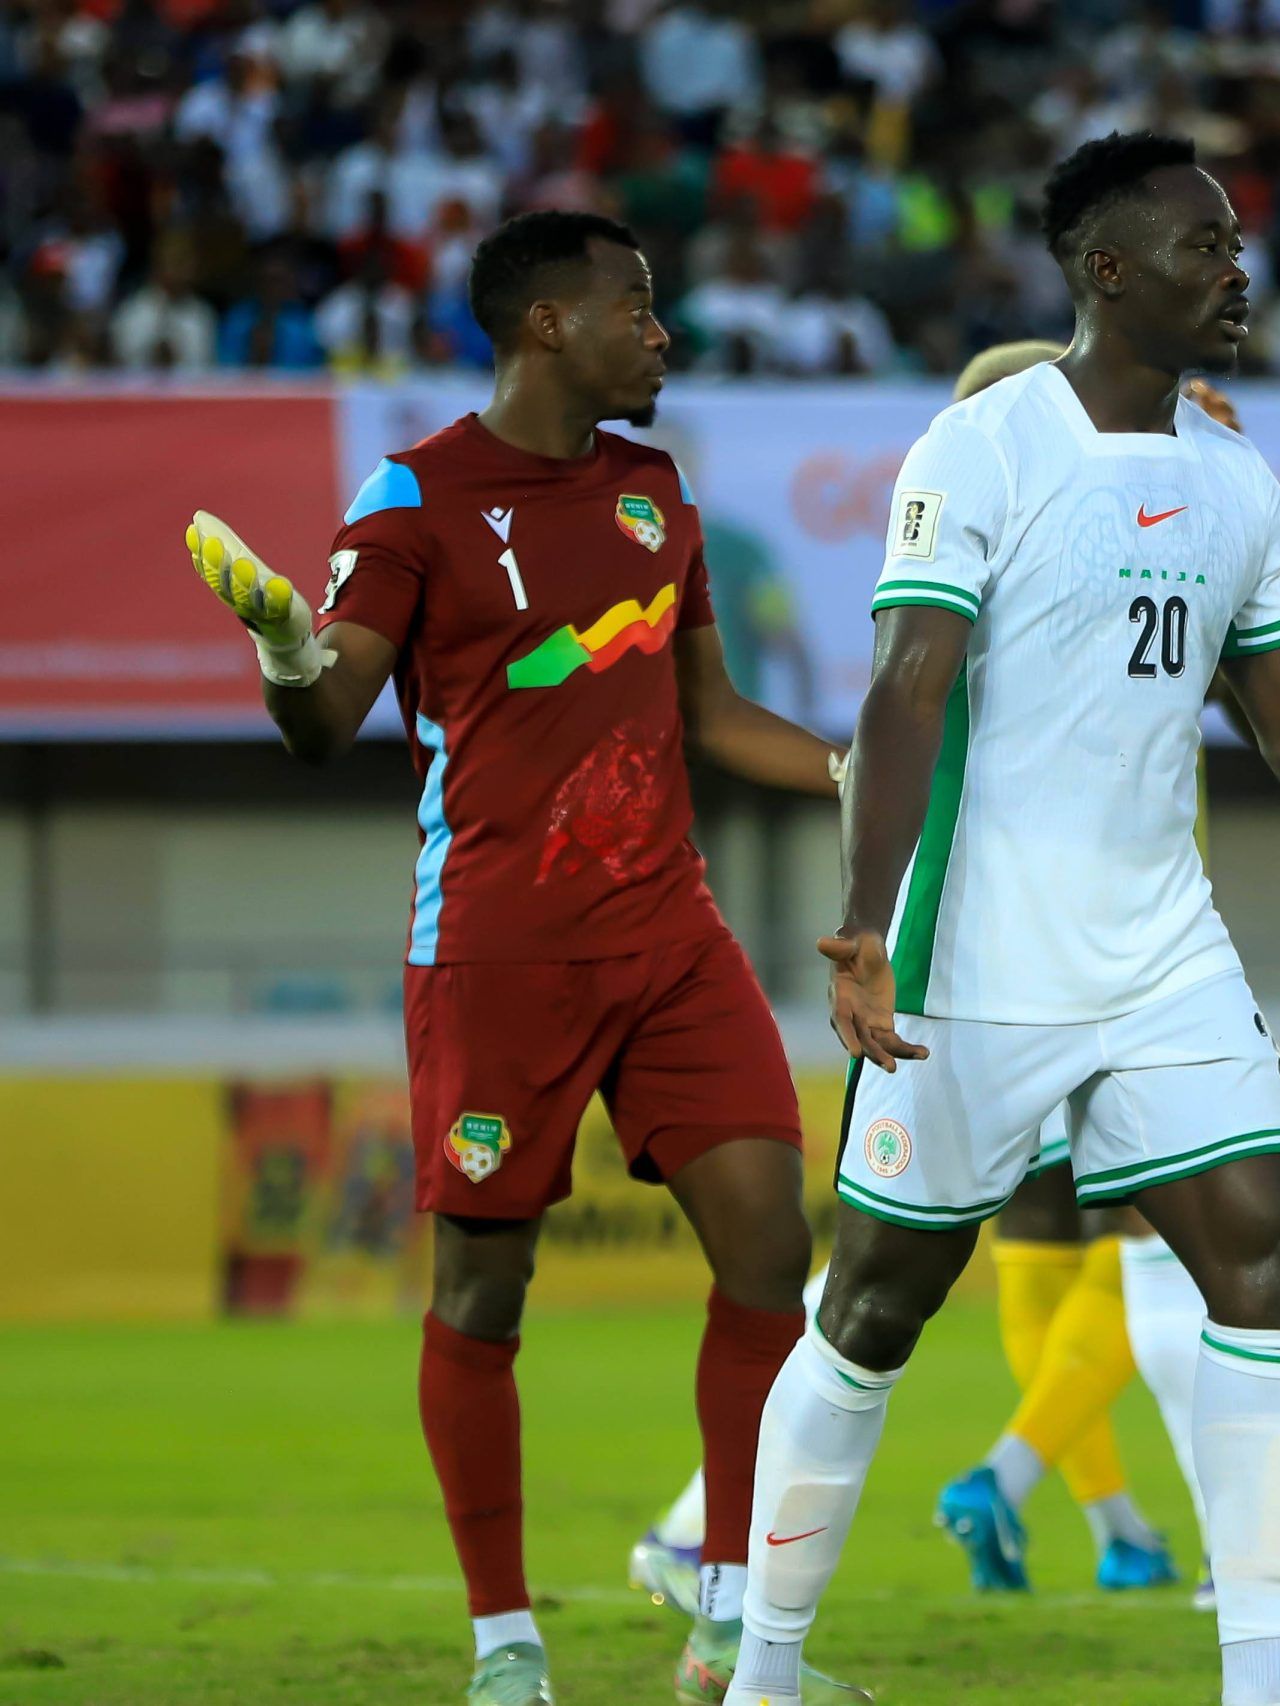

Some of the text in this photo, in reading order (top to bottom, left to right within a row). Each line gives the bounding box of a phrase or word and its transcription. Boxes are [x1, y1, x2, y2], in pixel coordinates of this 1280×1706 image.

[497, 547, 529, 611] 1
[1118, 568, 1207, 585] NAIJA
[1127, 595, 1189, 679] 20
